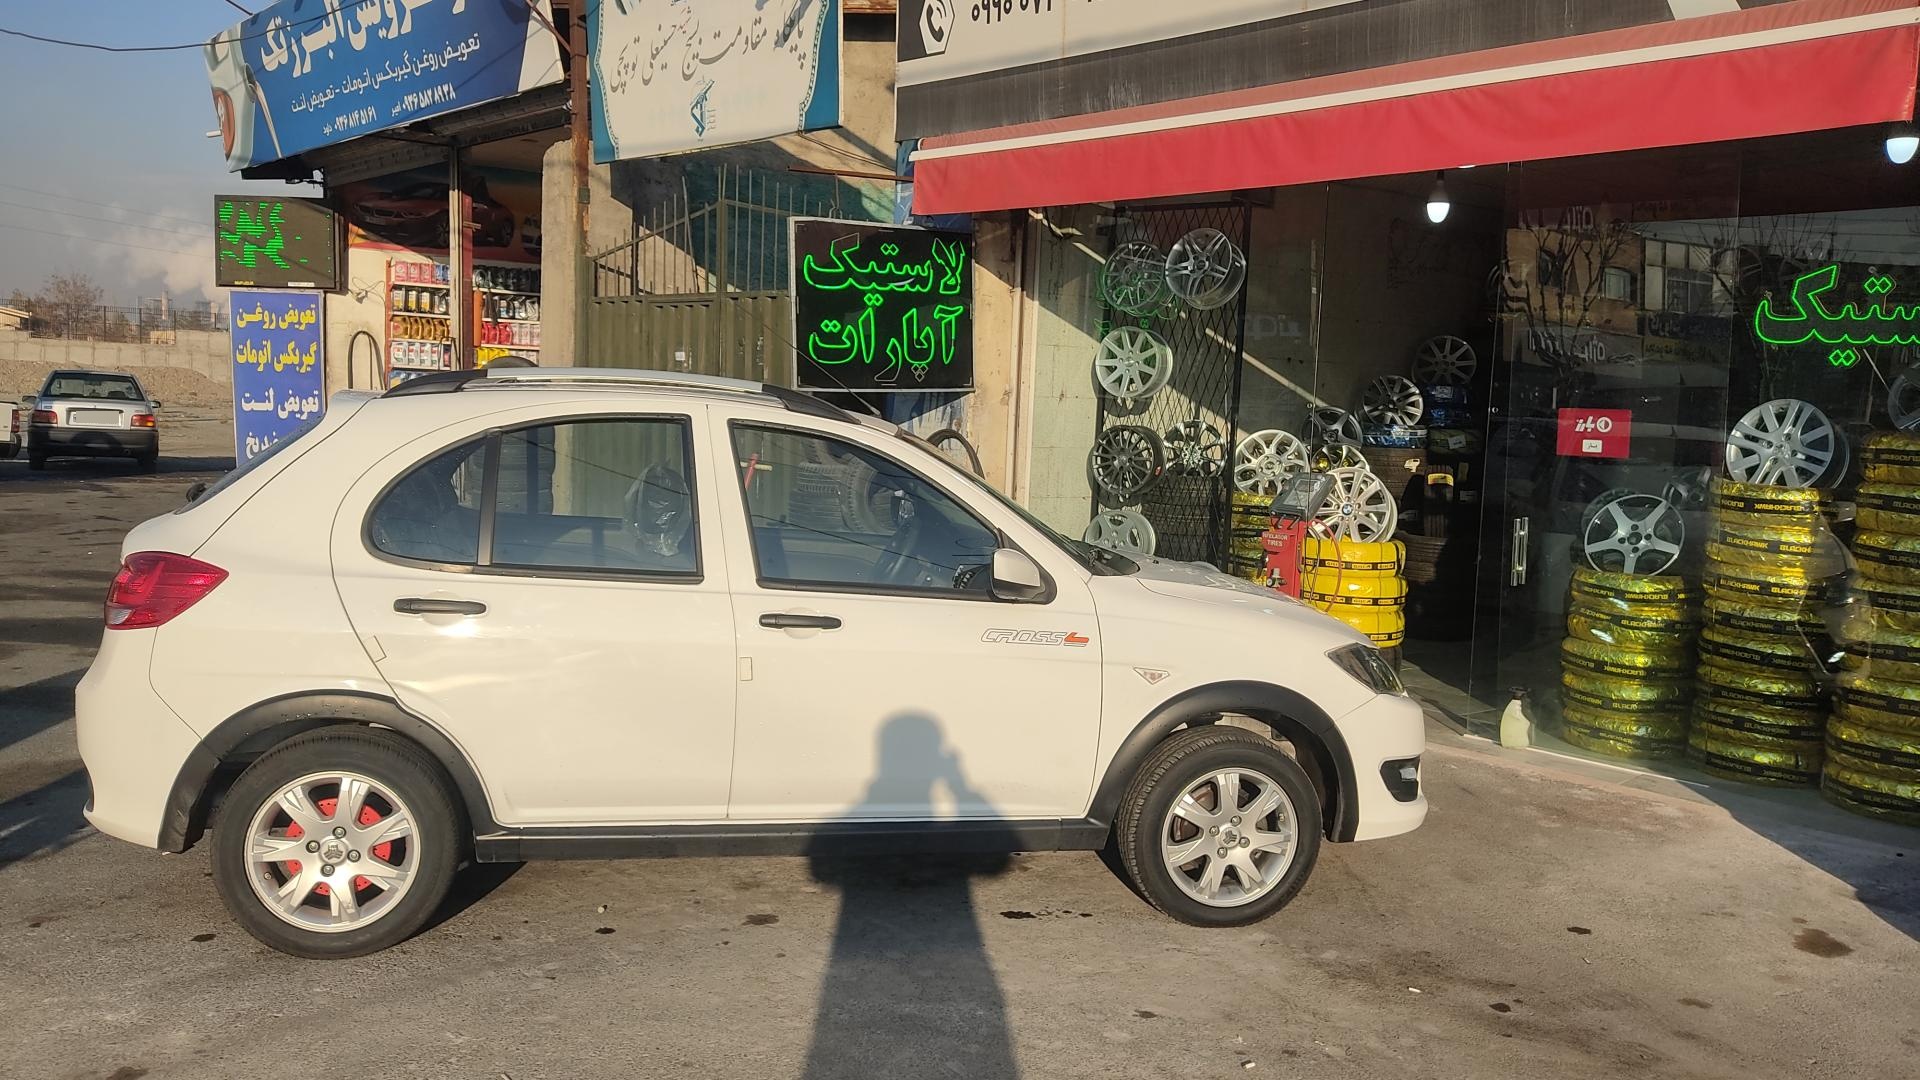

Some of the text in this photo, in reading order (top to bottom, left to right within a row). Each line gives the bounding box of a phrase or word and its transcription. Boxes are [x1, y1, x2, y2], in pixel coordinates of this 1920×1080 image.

[348, 0, 433, 50] رویس
[412, 49, 440, 76] روغن
[441, 32, 481, 67] تعویض
[342, 68, 371, 96] اتومات
[372, 50, 411, 89] گیربکس
[291, 93, 306, 113] لنت
[307, 84, 335, 112] تعویض
[803, 232, 966, 306] لاستیک
[236, 302, 316, 331] تعویض روغن
[236, 339, 317, 374] گیربکس اتومات
[808, 304, 965, 382] آپارات
[241, 386, 319, 420] تعویض لنت
[1726, 536, 1768, 549] BLACKHAWK
[1720, 578, 1760, 591] BLACKHAWK
[980, 628, 1068, 646] CROSS
